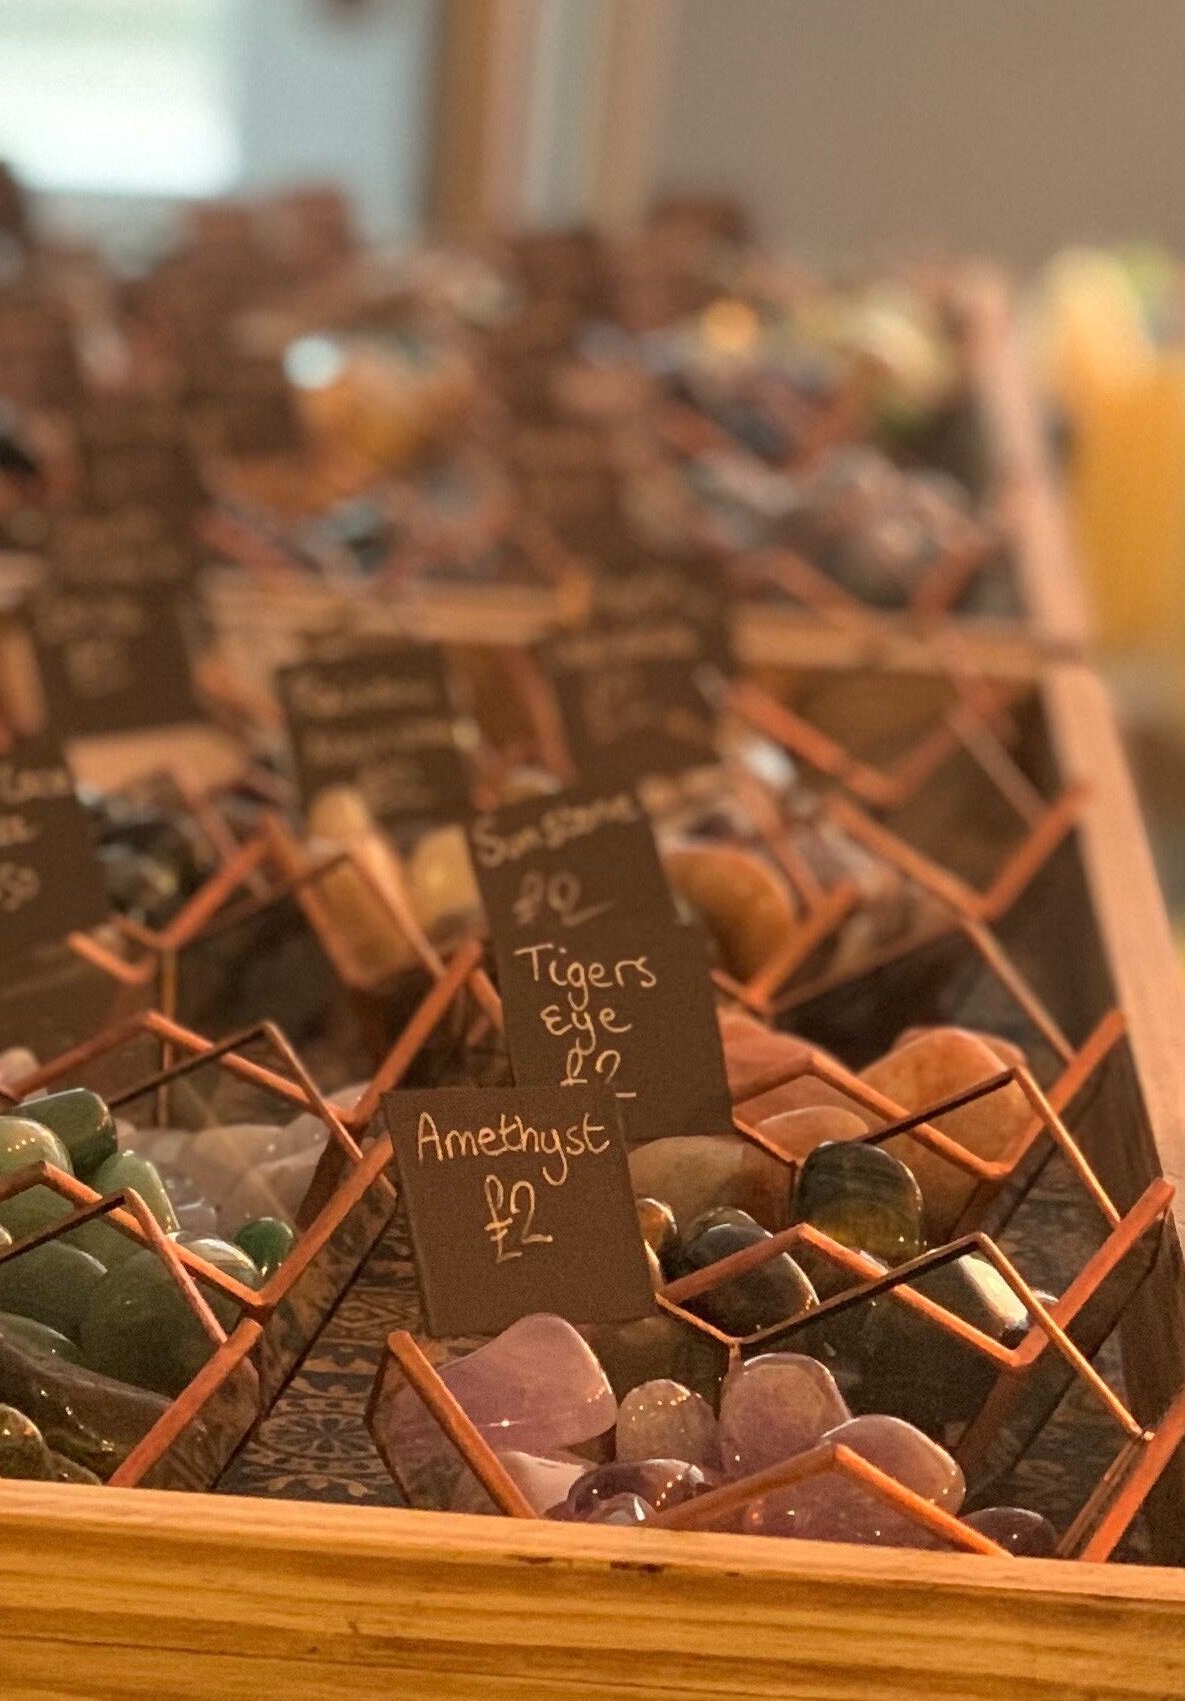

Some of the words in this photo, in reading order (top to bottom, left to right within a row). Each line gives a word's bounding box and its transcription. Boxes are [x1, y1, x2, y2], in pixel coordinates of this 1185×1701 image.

[514, 942, 658, 1012] Tigers
[416, 1111, 612, 1187] Amethyst
[483, 1174, 554, 1264] £2
